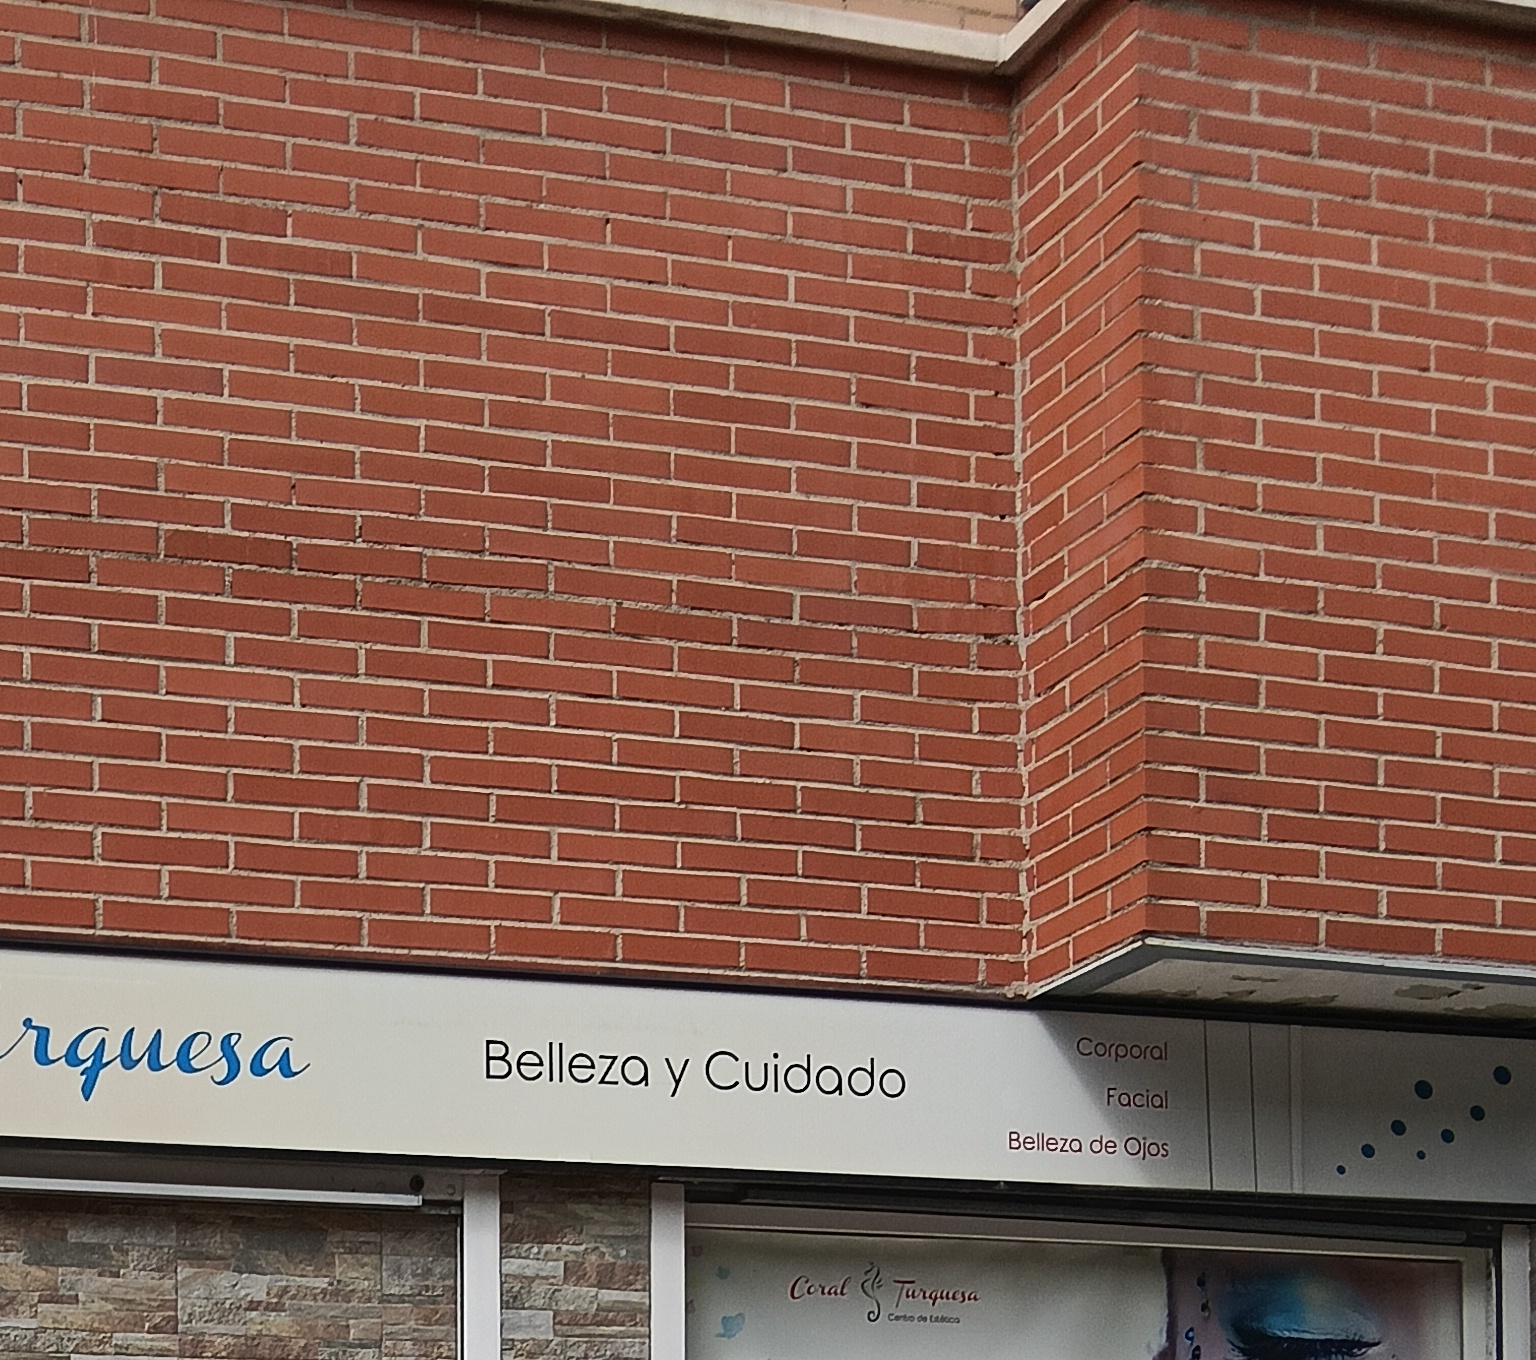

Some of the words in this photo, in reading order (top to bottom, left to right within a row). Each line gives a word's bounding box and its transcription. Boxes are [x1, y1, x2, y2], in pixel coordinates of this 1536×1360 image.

[1075, 1036, 1170, 1066] Corporal
[483, 1039, 651, 1090] Belleza
[664, 1053, 691, 1097] y
[703, 1049, 908, 1100] Cuidado
[1105, 1086, 1170, 1111] Facial
[1006, 1130, 1083, 1155] Belleza
[1089, 1134, 1118, 1157] de
[1122, 1135, 1171, 1161] Ojos
[790, 1275, 850, 1300] Coral
[893, 1279, 980, 1308] Turquesa
